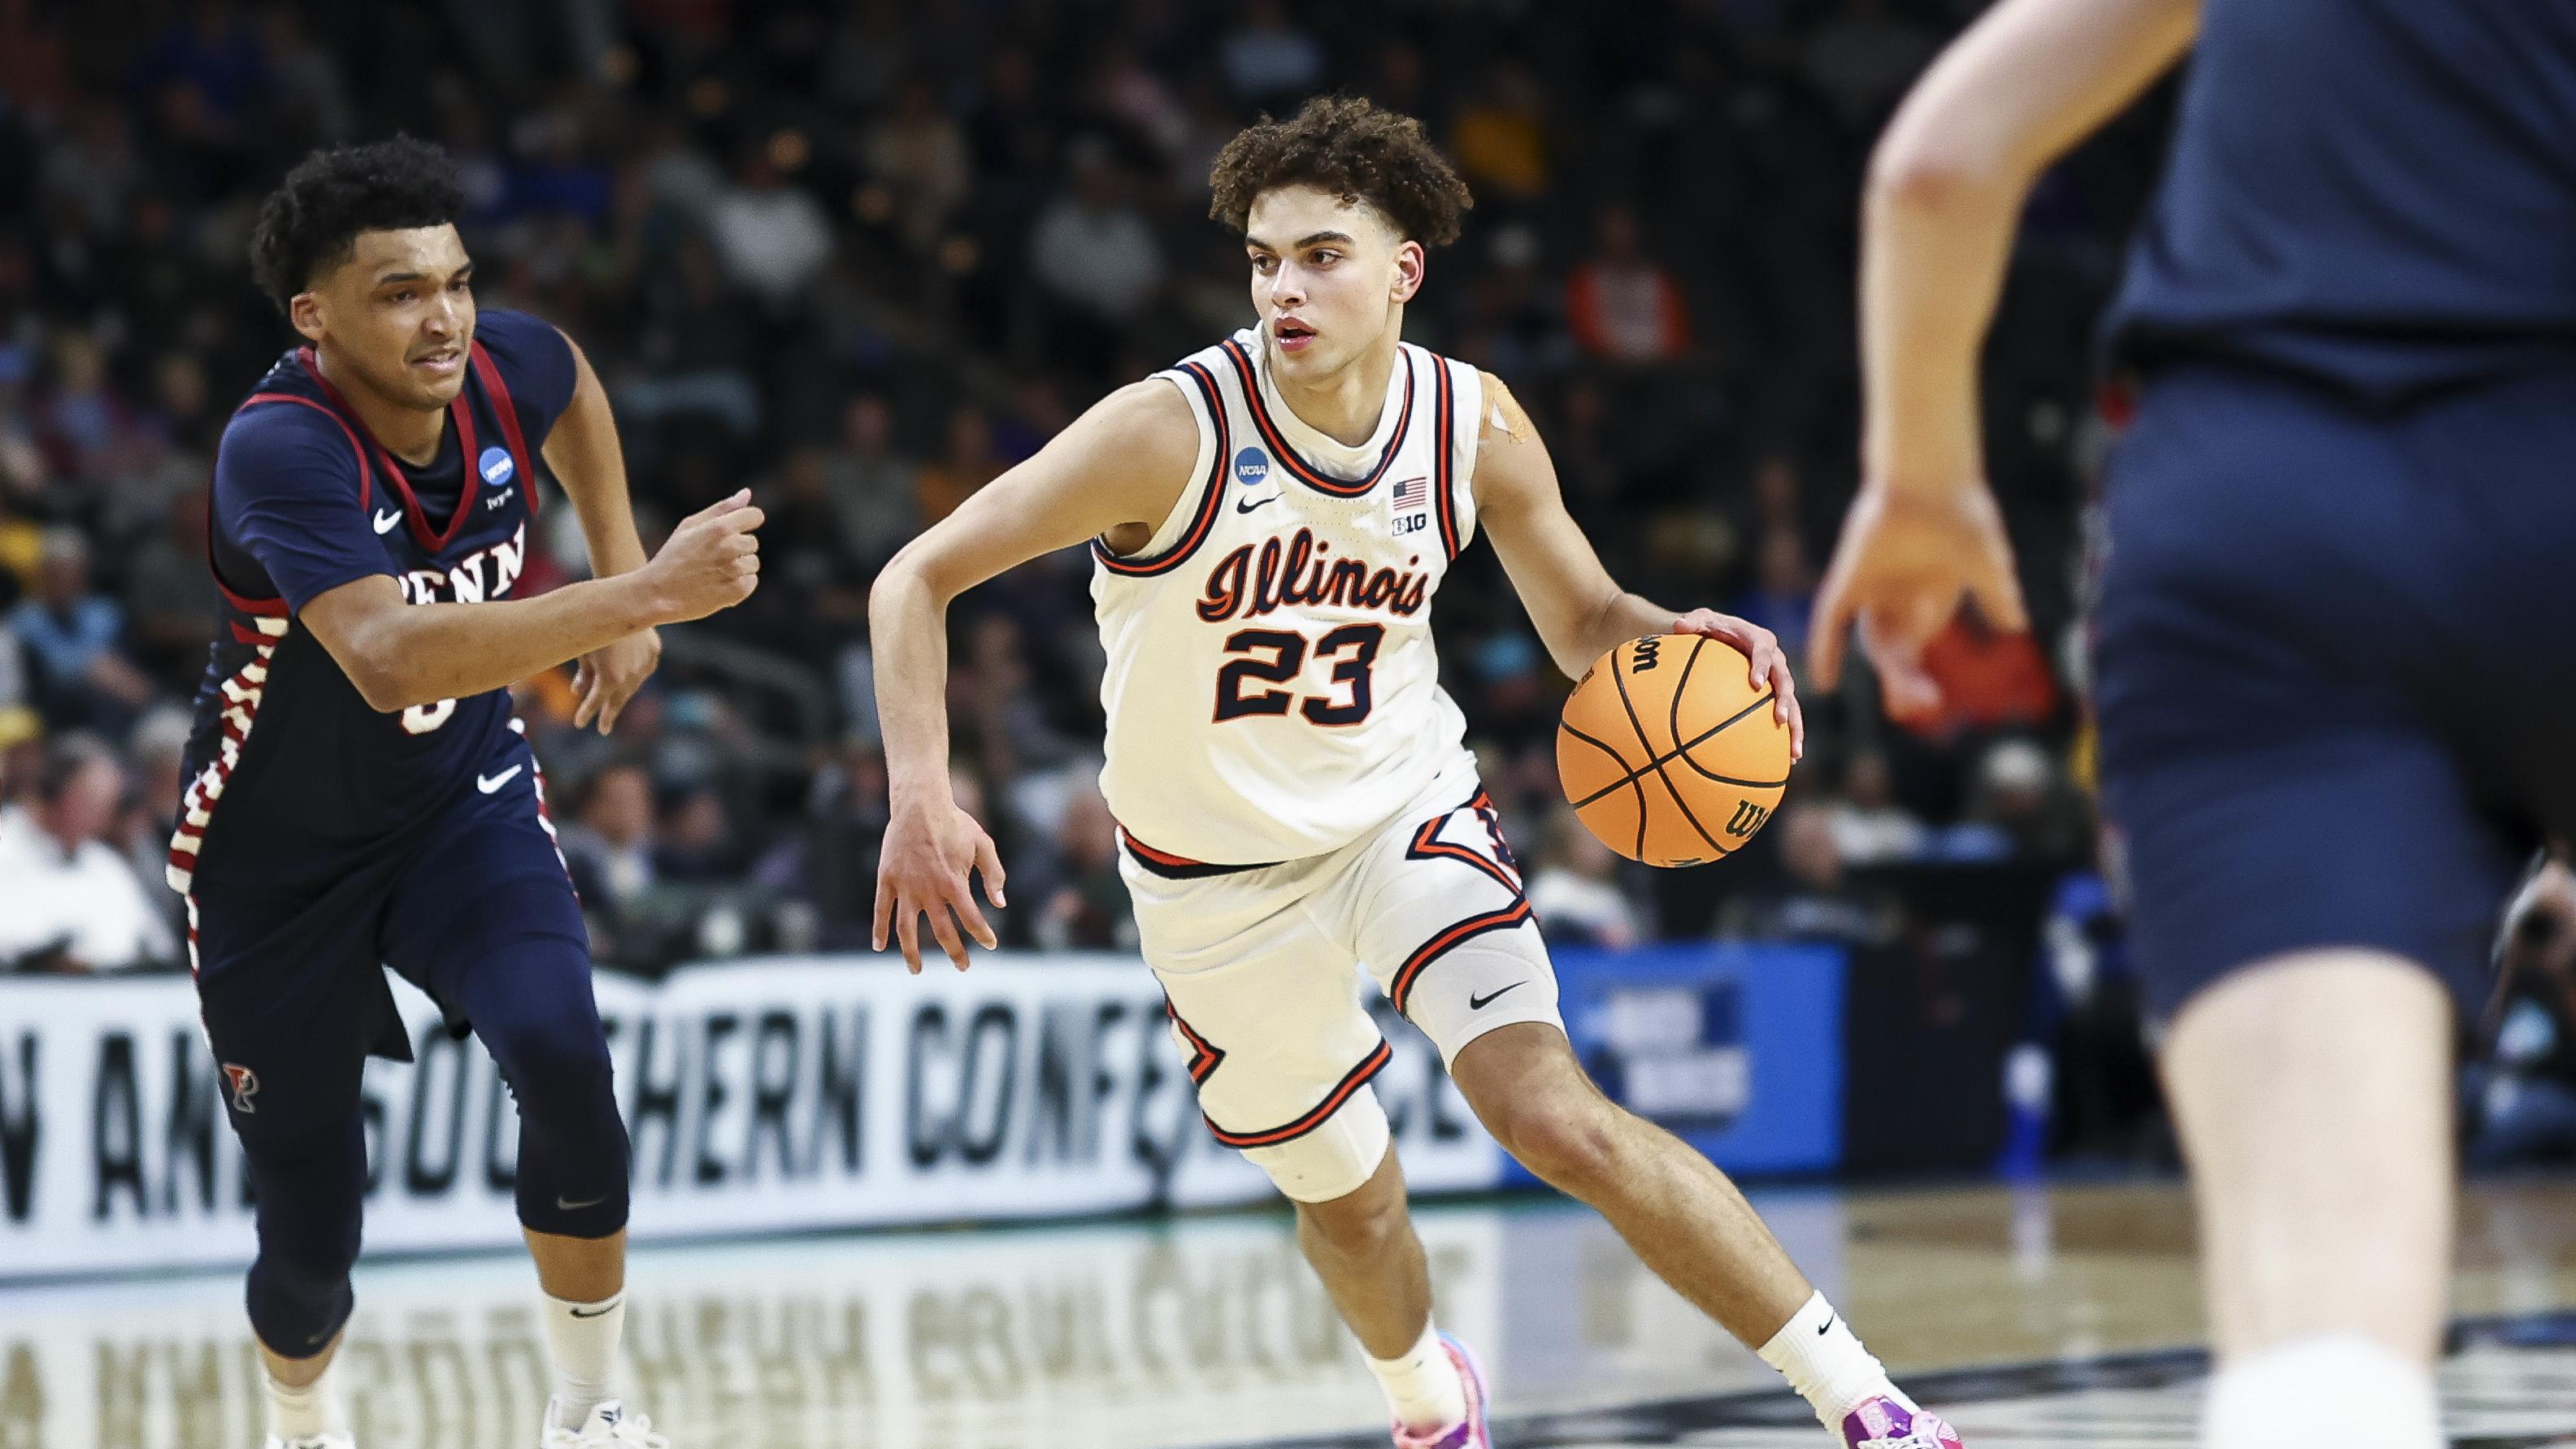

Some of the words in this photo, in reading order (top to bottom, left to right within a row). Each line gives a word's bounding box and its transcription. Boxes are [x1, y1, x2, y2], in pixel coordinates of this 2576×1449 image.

[1238, 465, 1266, 476] NCAA
[397, 518, 527, 605] ENN
[1196, 527, 1429, 623] Illinois
[1211, 623, 1386, 727] 23
[91, 1026, 258, 1221] AN
[360, 1009, 868, 1196] OHERN
